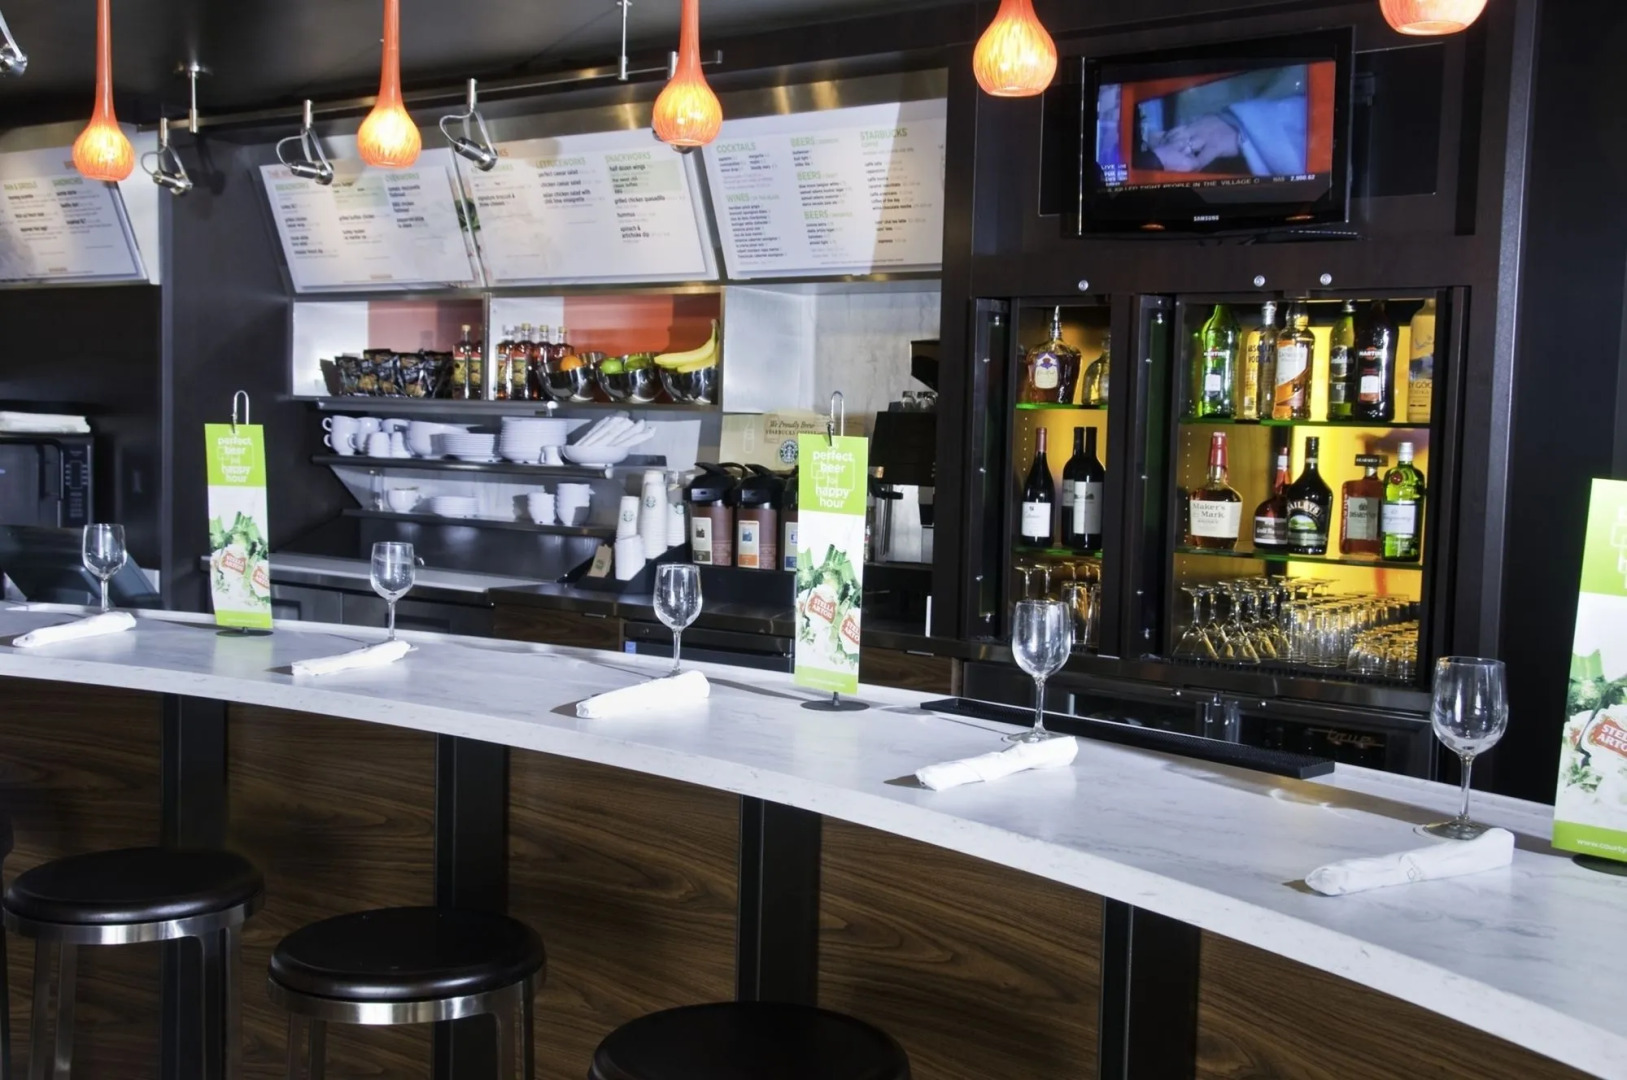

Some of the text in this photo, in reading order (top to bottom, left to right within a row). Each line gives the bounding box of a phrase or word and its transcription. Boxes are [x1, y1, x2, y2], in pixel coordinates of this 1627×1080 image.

[860, 127, 908, 141] STARBUCKS
[716, 142, 756, 153] COCKTAILS
[217, 436, 253, 445] perfect
[812, 450, 854, 462] perfect
[221, 464, 250, 475] happy
[820, 461, 846, 473] beer
[225, 473, 248, 483] hour
[815, 486, 849, 499] happy
[820, 496, 845, 508] hour
[1192, 502, 1226, 510] Maker's
[1287, 500, 1321, 515] AILEYS
[1201, 510, 1225, 518] Mark
[1601, 723, 1627, 741] STEL
[1596, 732, 1627, 752] ARTO
